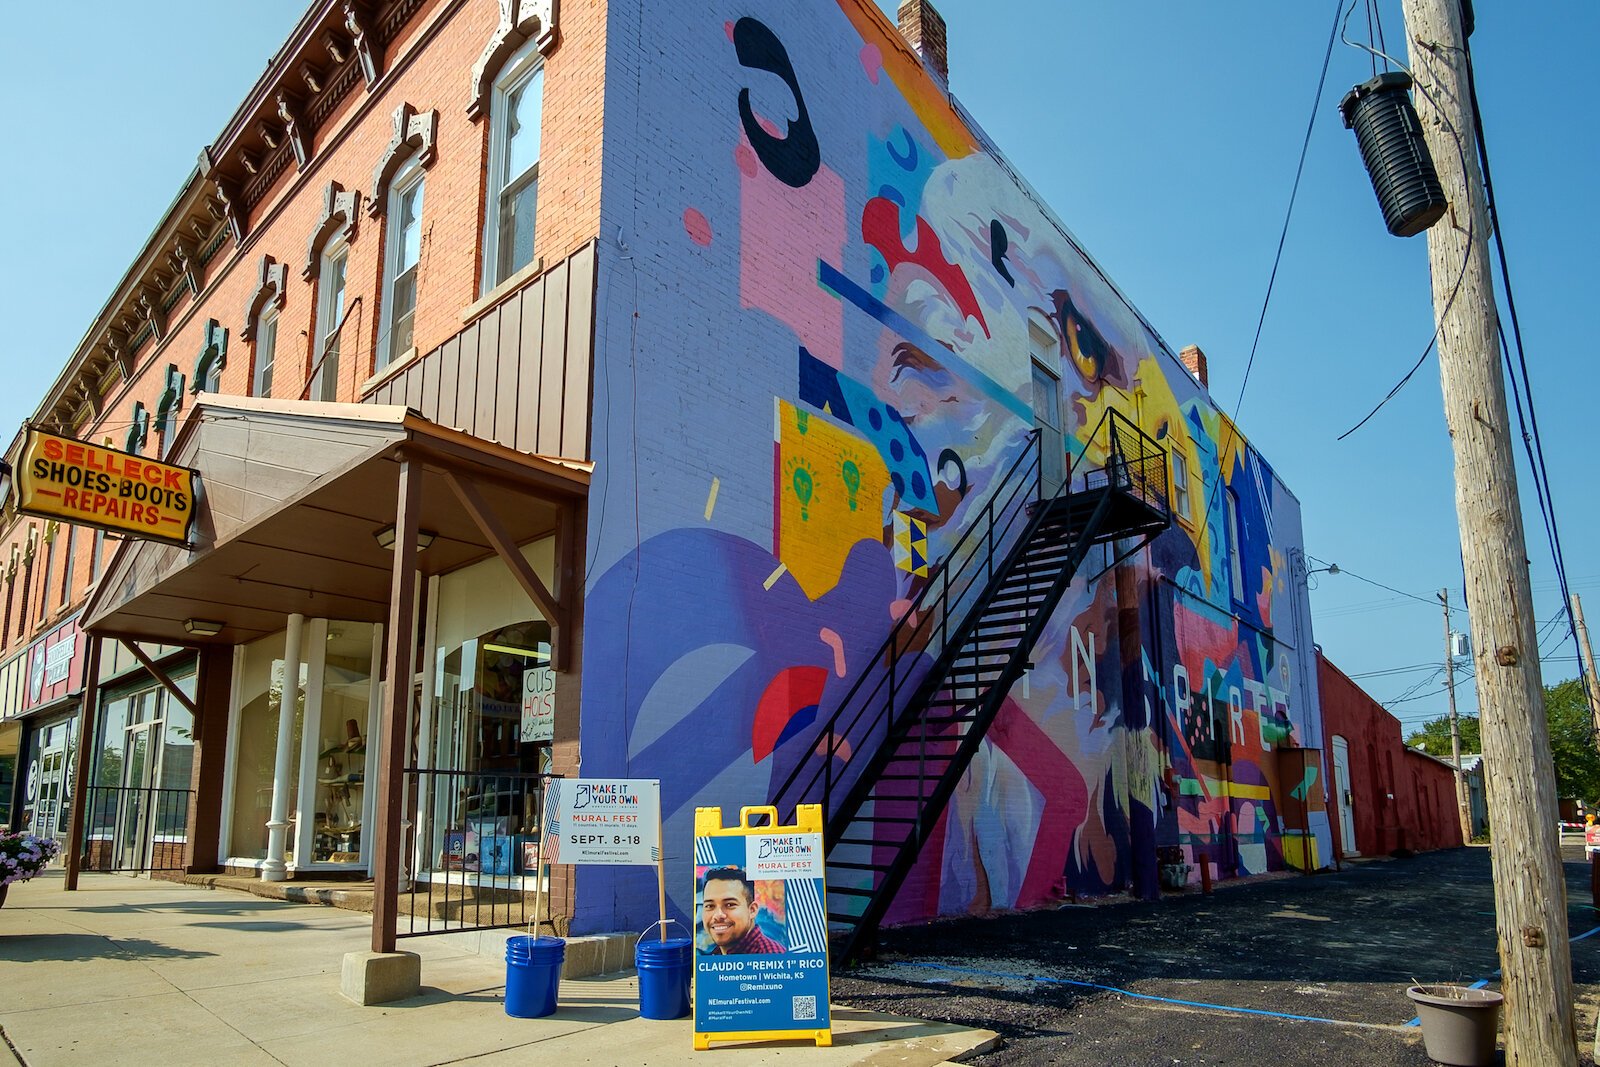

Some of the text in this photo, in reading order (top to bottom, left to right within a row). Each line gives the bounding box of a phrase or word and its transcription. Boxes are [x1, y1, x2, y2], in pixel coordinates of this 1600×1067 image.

[44, 439, 184, 491] SELLECK
[63, 488, 159, 525] REPAIRS
[526, 669, 553, 693] CUS
[592, 784, 628, 794] MAKE IT
[592, 795, 638, 804] YOUR OWN
[571, 834, 640, 845] SEPT. 8-18
[773, 837, 803, 846] MAKE IT
[773, 845, 812, 854] YOUR OWN
[698, 961, 744, 972] CLAUDIO
[799, 958, 824, 969] RICO
[719, 973, 757, 981] Hometown
[763, 972, 793, 980] Wichita,
